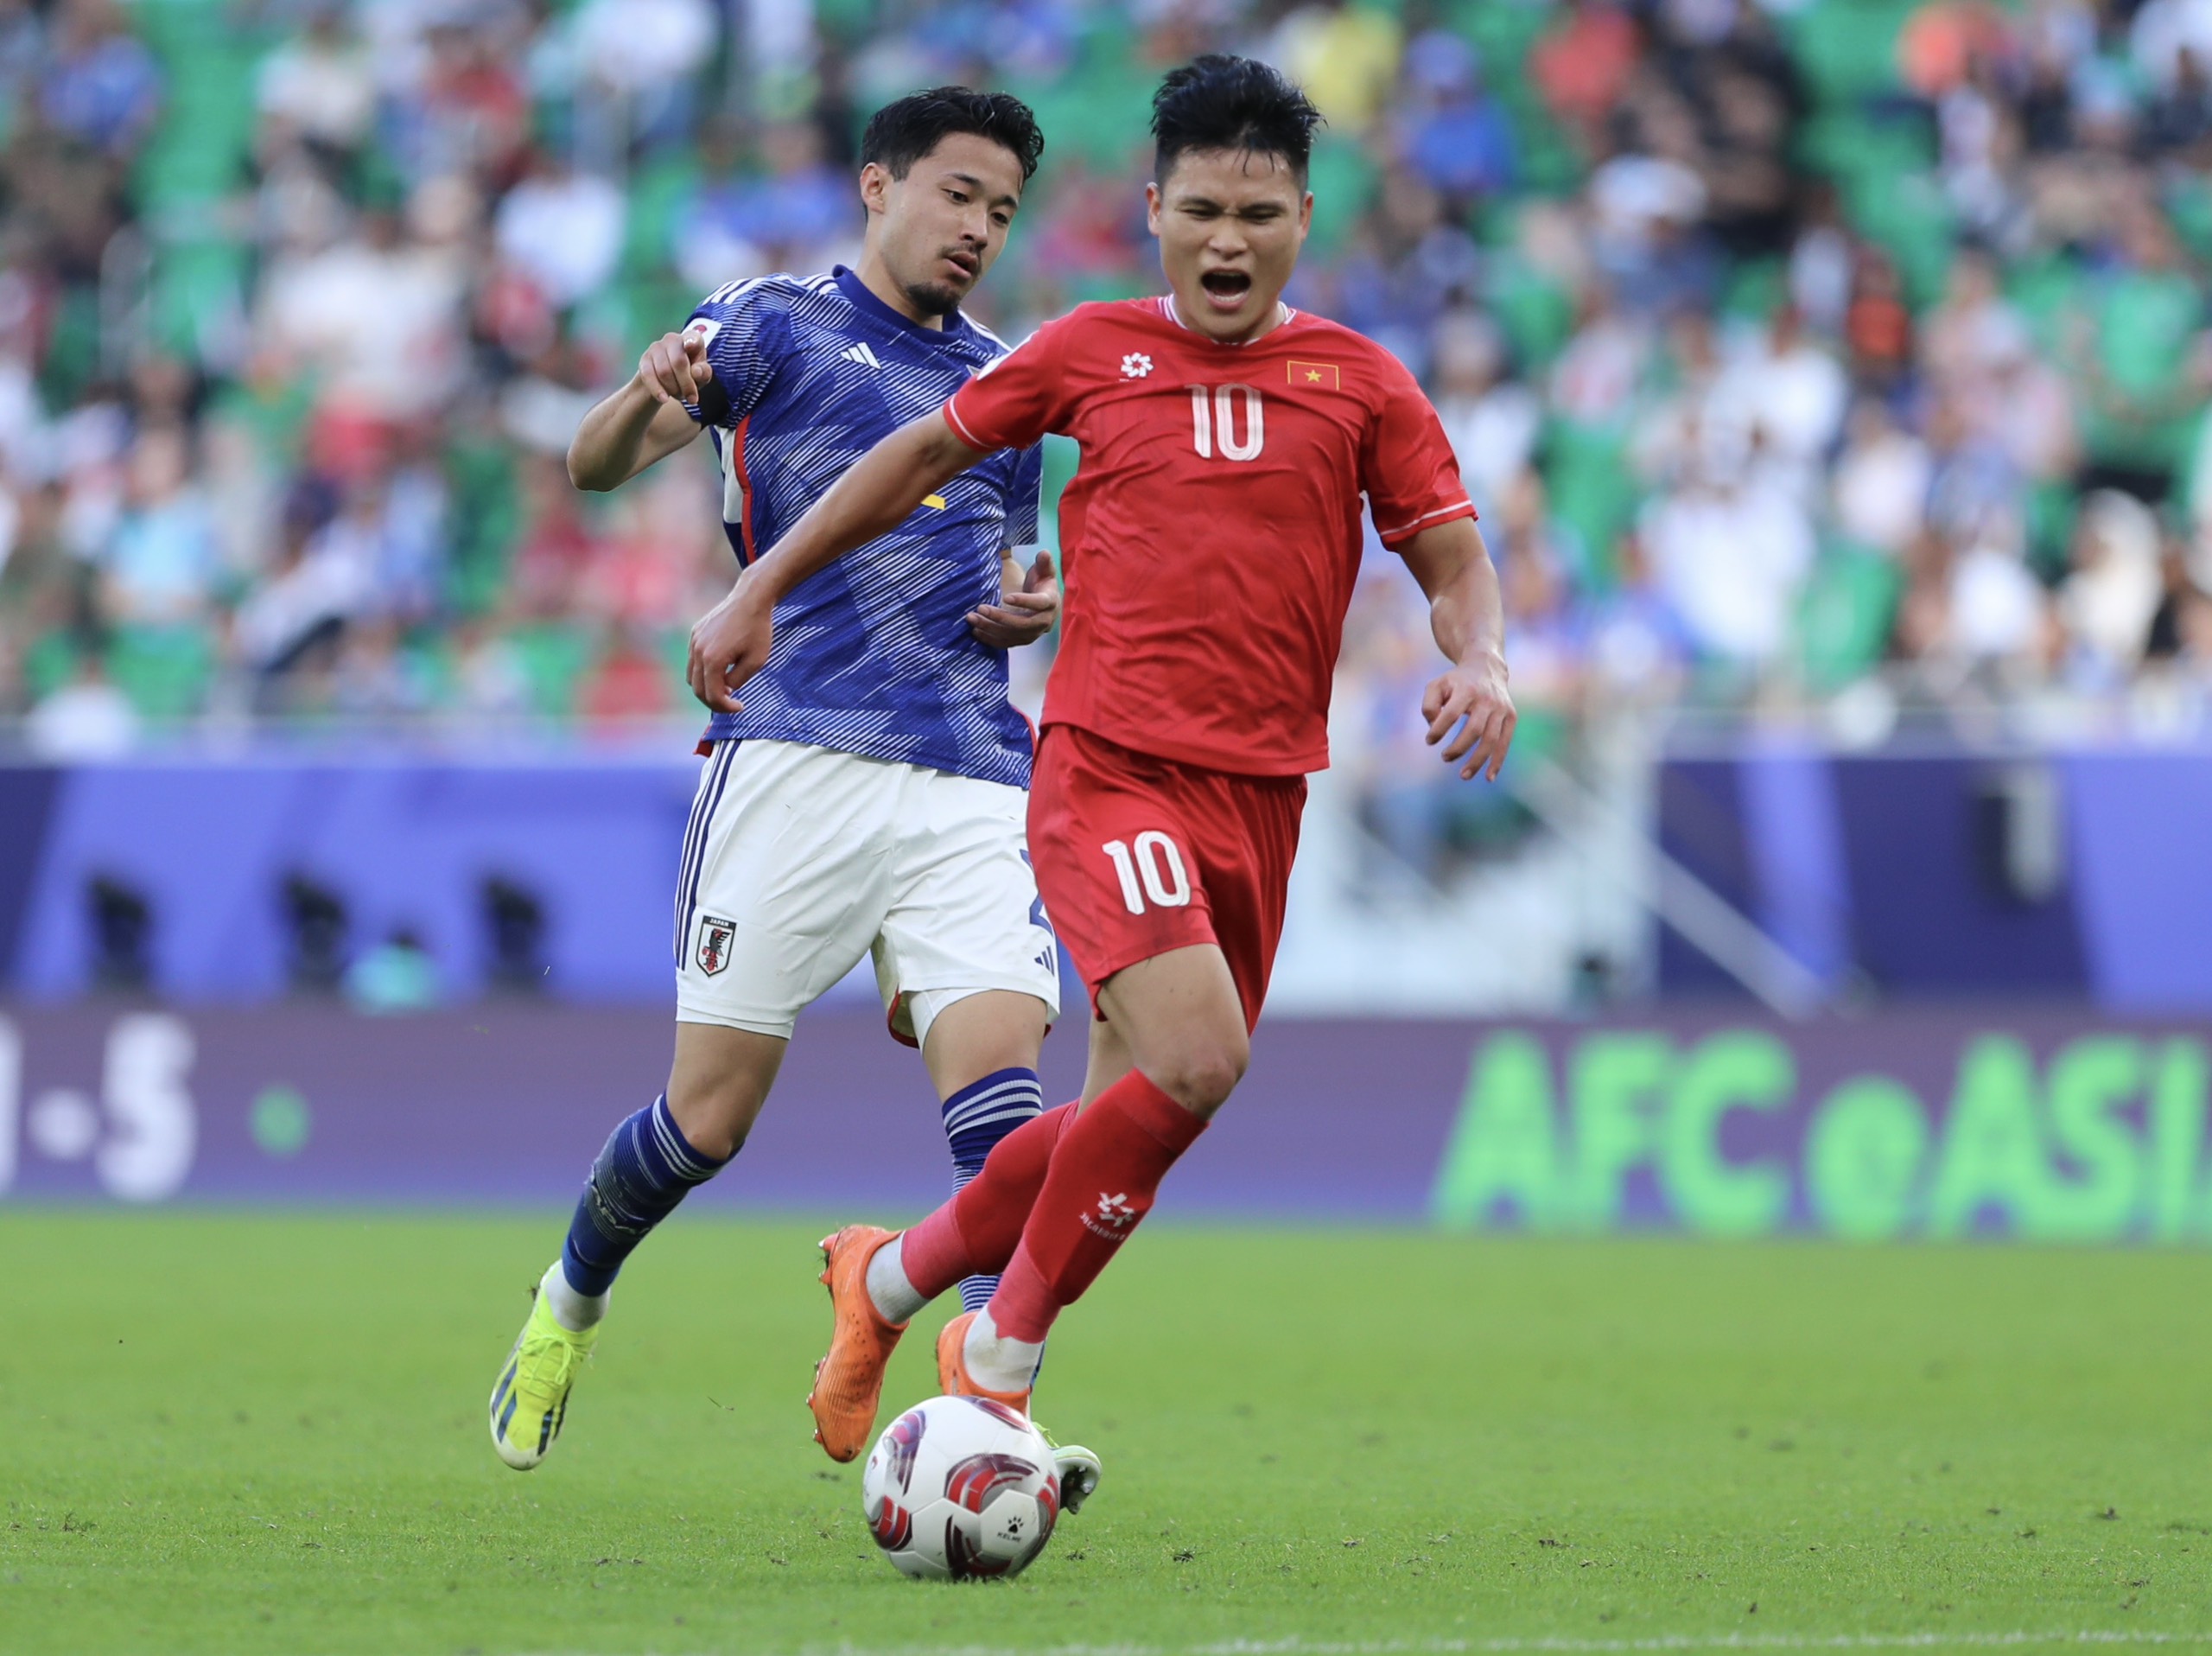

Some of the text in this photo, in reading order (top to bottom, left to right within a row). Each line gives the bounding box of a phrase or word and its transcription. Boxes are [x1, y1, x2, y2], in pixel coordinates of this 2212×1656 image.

[1184, 383, 1264, 462] 10
[1102, 830, 1191, 915] 10
[709, 918, 729, 927] JAPAN
[1430, 1030, 1799, 1239] AFC
